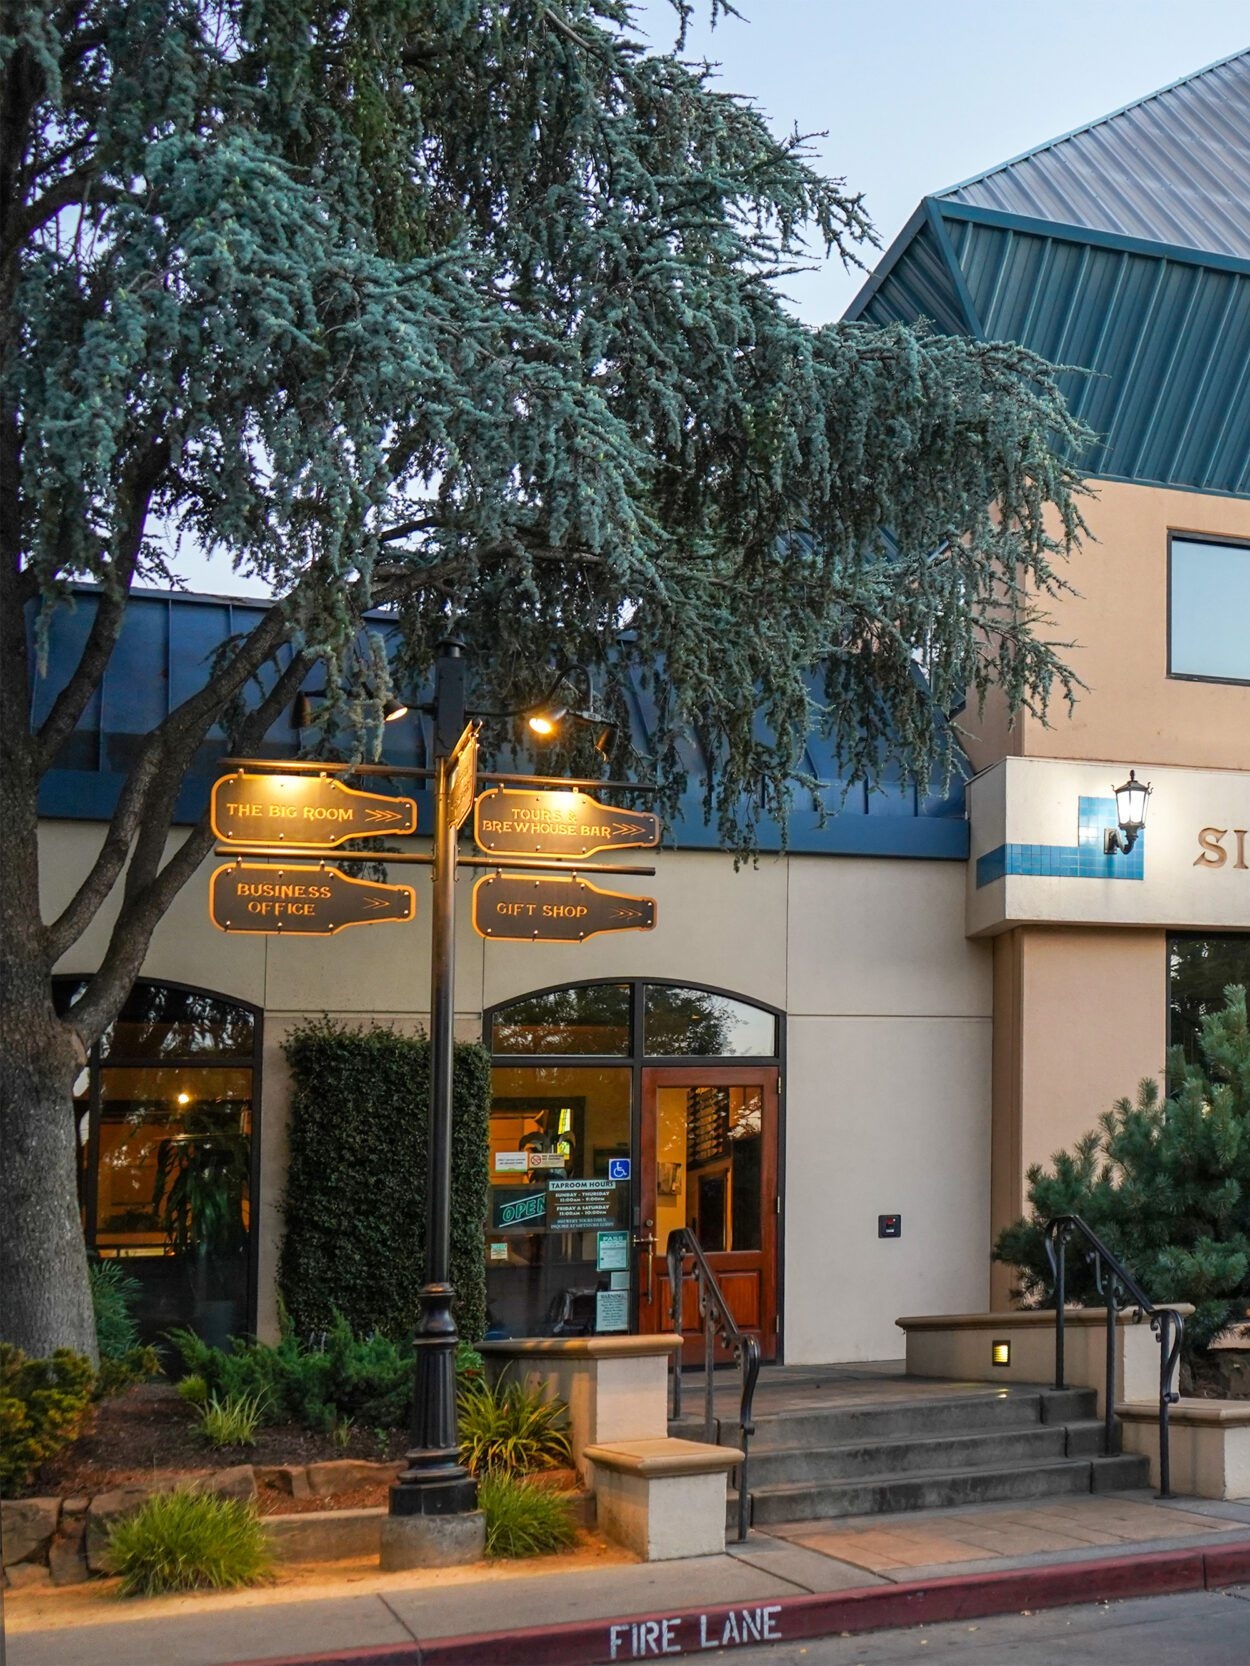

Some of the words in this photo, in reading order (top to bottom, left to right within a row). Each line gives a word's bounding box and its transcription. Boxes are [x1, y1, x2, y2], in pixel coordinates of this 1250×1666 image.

[227, 803, 263, 817] THE
[268, 804, 297, 818] BIG
[303, 806, 353, 822] ROOM
[511, 808, 564, 823] TOURS
[567, 809, 577, 824] &
[482, 820, 577, 835] BREWHOUSE
[580, 824, 611, 839] BAR
[237, 883, 332, 899] BUSINESS
[248, 901, 315, 916] OFFICE
[496, 902, 537, 916] GIFT
[542, 904, 588, 918] SHOP
[610, 1618, 682, 1659] FIRE
[700, 1605, 782, 1648] LANE
